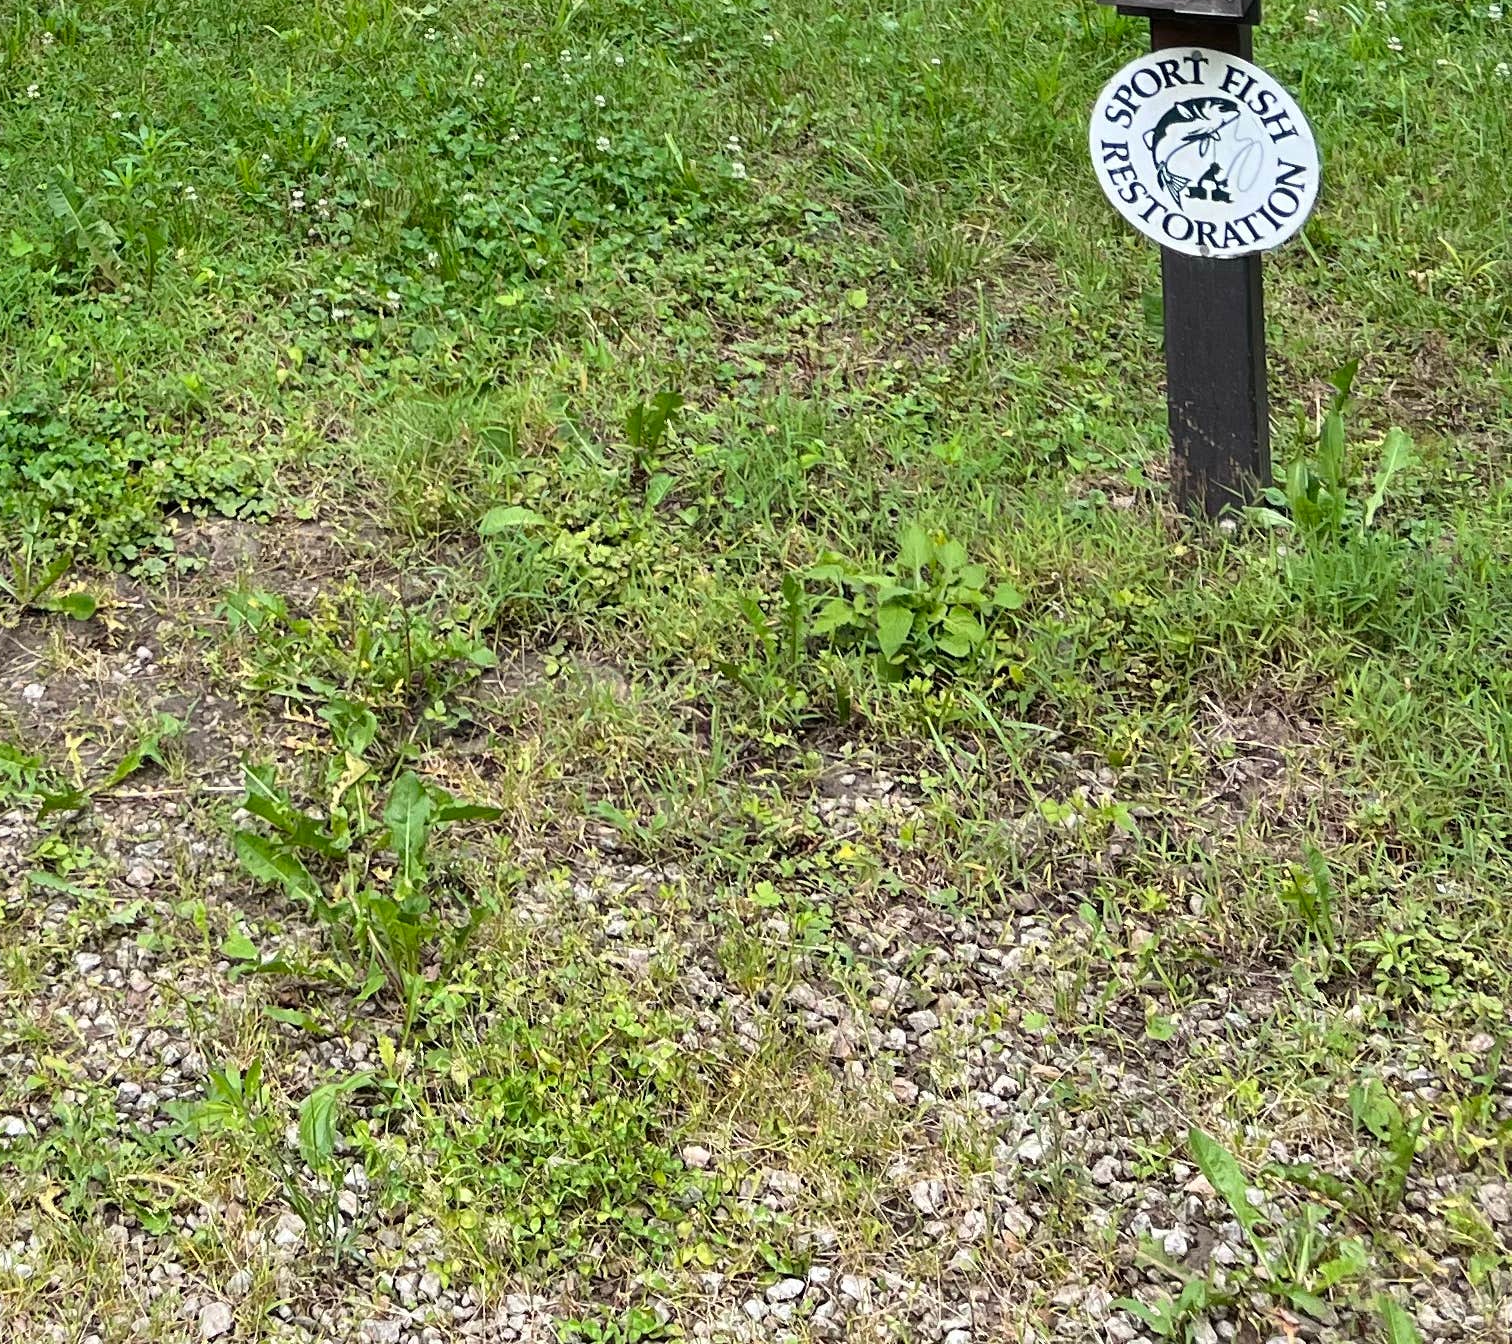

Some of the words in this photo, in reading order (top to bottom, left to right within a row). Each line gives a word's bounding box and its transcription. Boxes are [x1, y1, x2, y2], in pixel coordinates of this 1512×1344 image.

[1105, 54, 1209, 130] SPORT
[1218, 63, 1298, 145] FISH
[1100, 140, 1308, 250] RESTORATION
